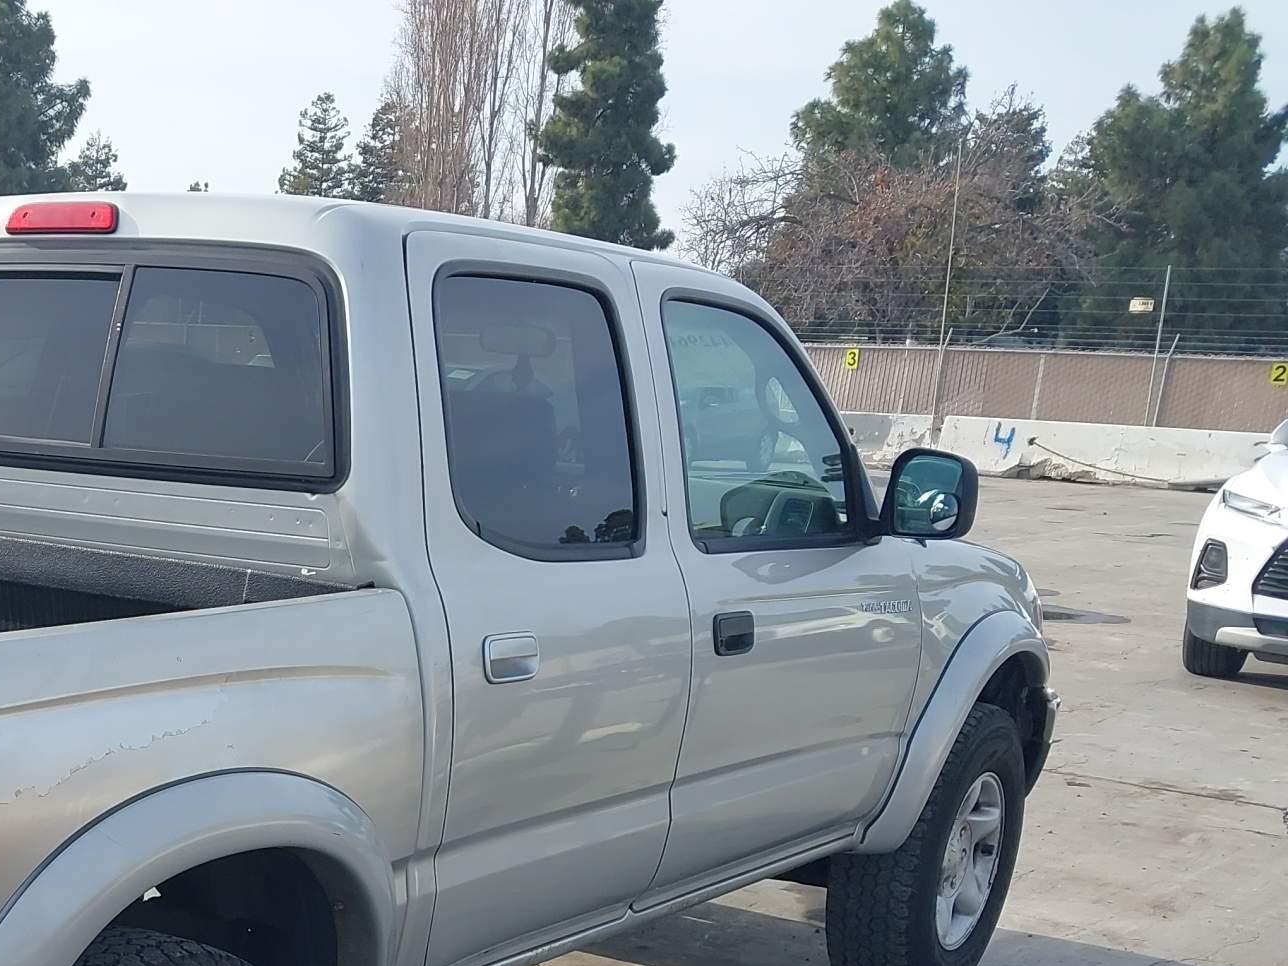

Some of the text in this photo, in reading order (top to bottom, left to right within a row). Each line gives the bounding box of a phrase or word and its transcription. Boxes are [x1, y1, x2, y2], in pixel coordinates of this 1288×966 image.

[847, 351, 856, 366] 3
[1273, 365, 1287, 382] 2
[994, 421, 1016, 460] 4
